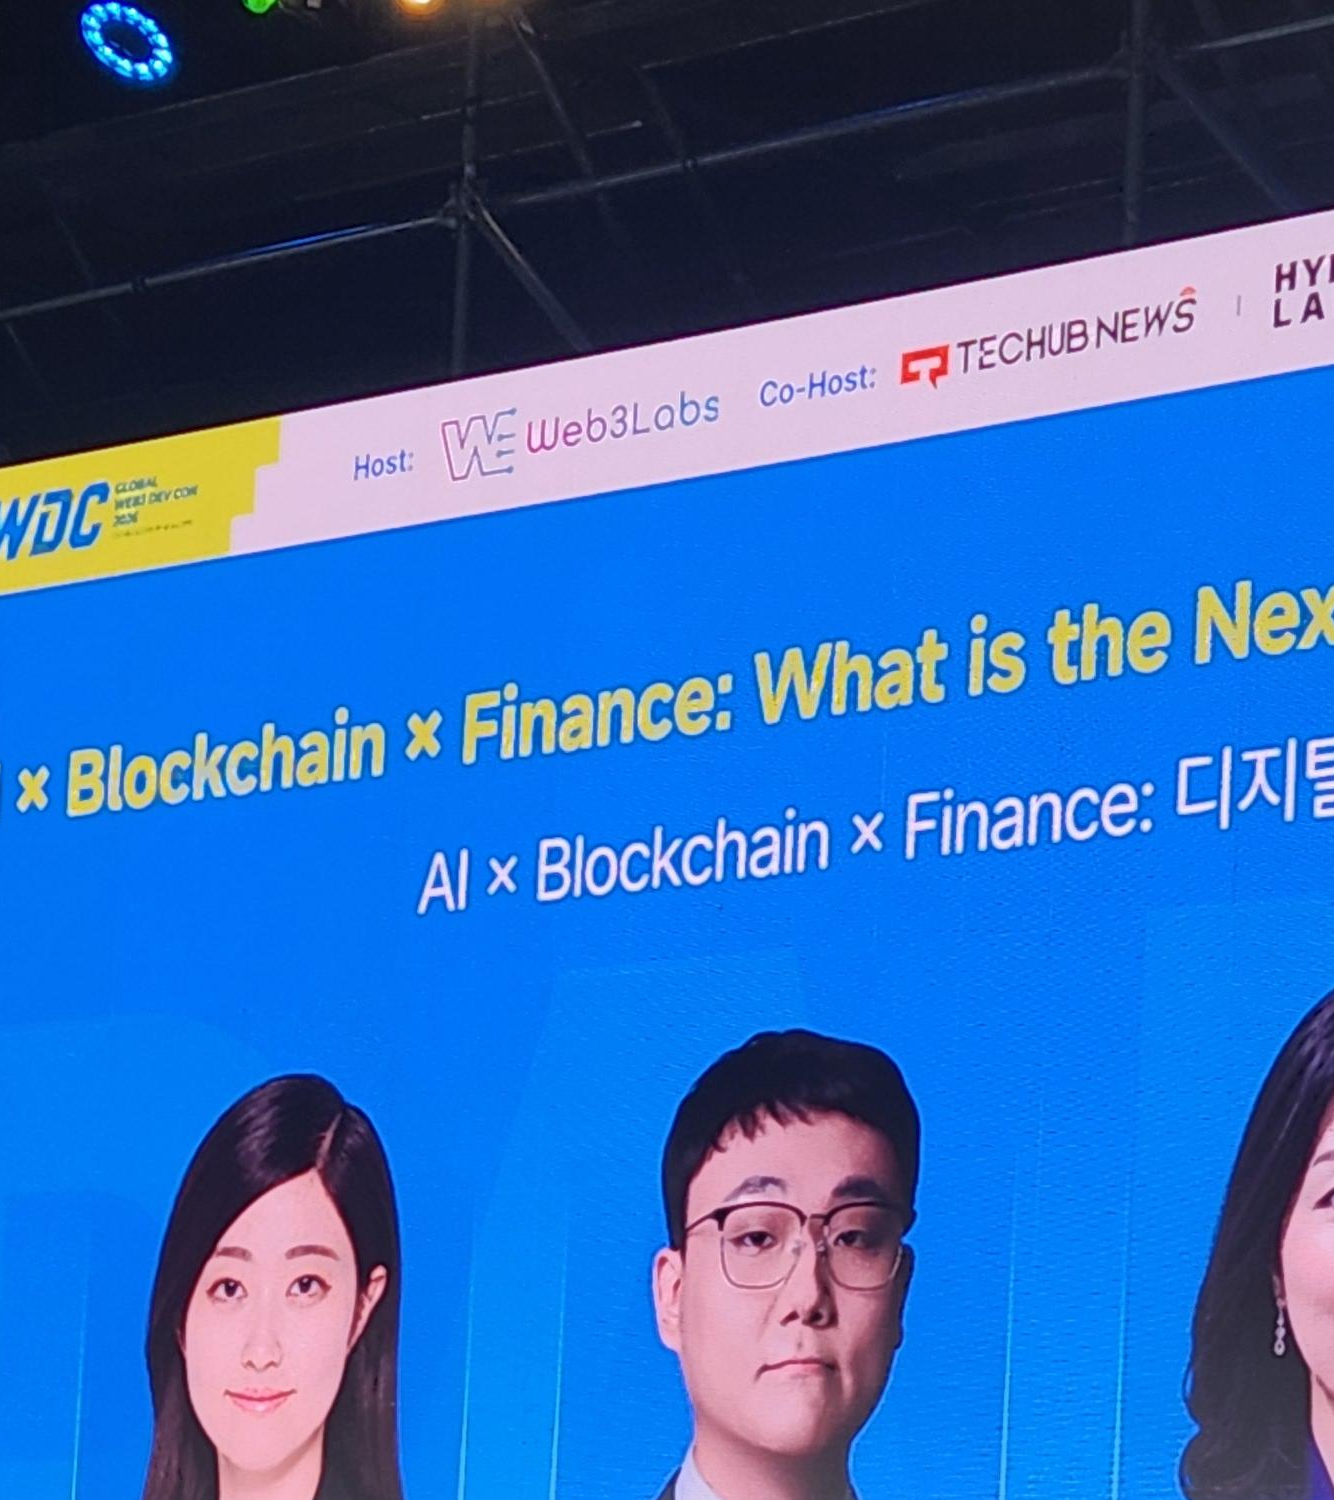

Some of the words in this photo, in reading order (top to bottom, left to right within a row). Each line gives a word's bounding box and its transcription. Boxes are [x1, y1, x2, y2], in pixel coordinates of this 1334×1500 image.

[759, 362, 878, 410] Co-Host:
[526, 390, 720, 456] Web3Labs
[353, 450, 415, 482] Host:
[67, 708, 386, 818] Blockchain
[462, 673, 733, 766] Finance:
[755, 627, 945, 725] What
[968, 614, 1026, 697] is
[1047, 602, 1171, 685] the
[415, 848, 468, 915] AI
[536, 807, 829, 904] Blockchain
[903, 782, 1154, 860] Finance:
